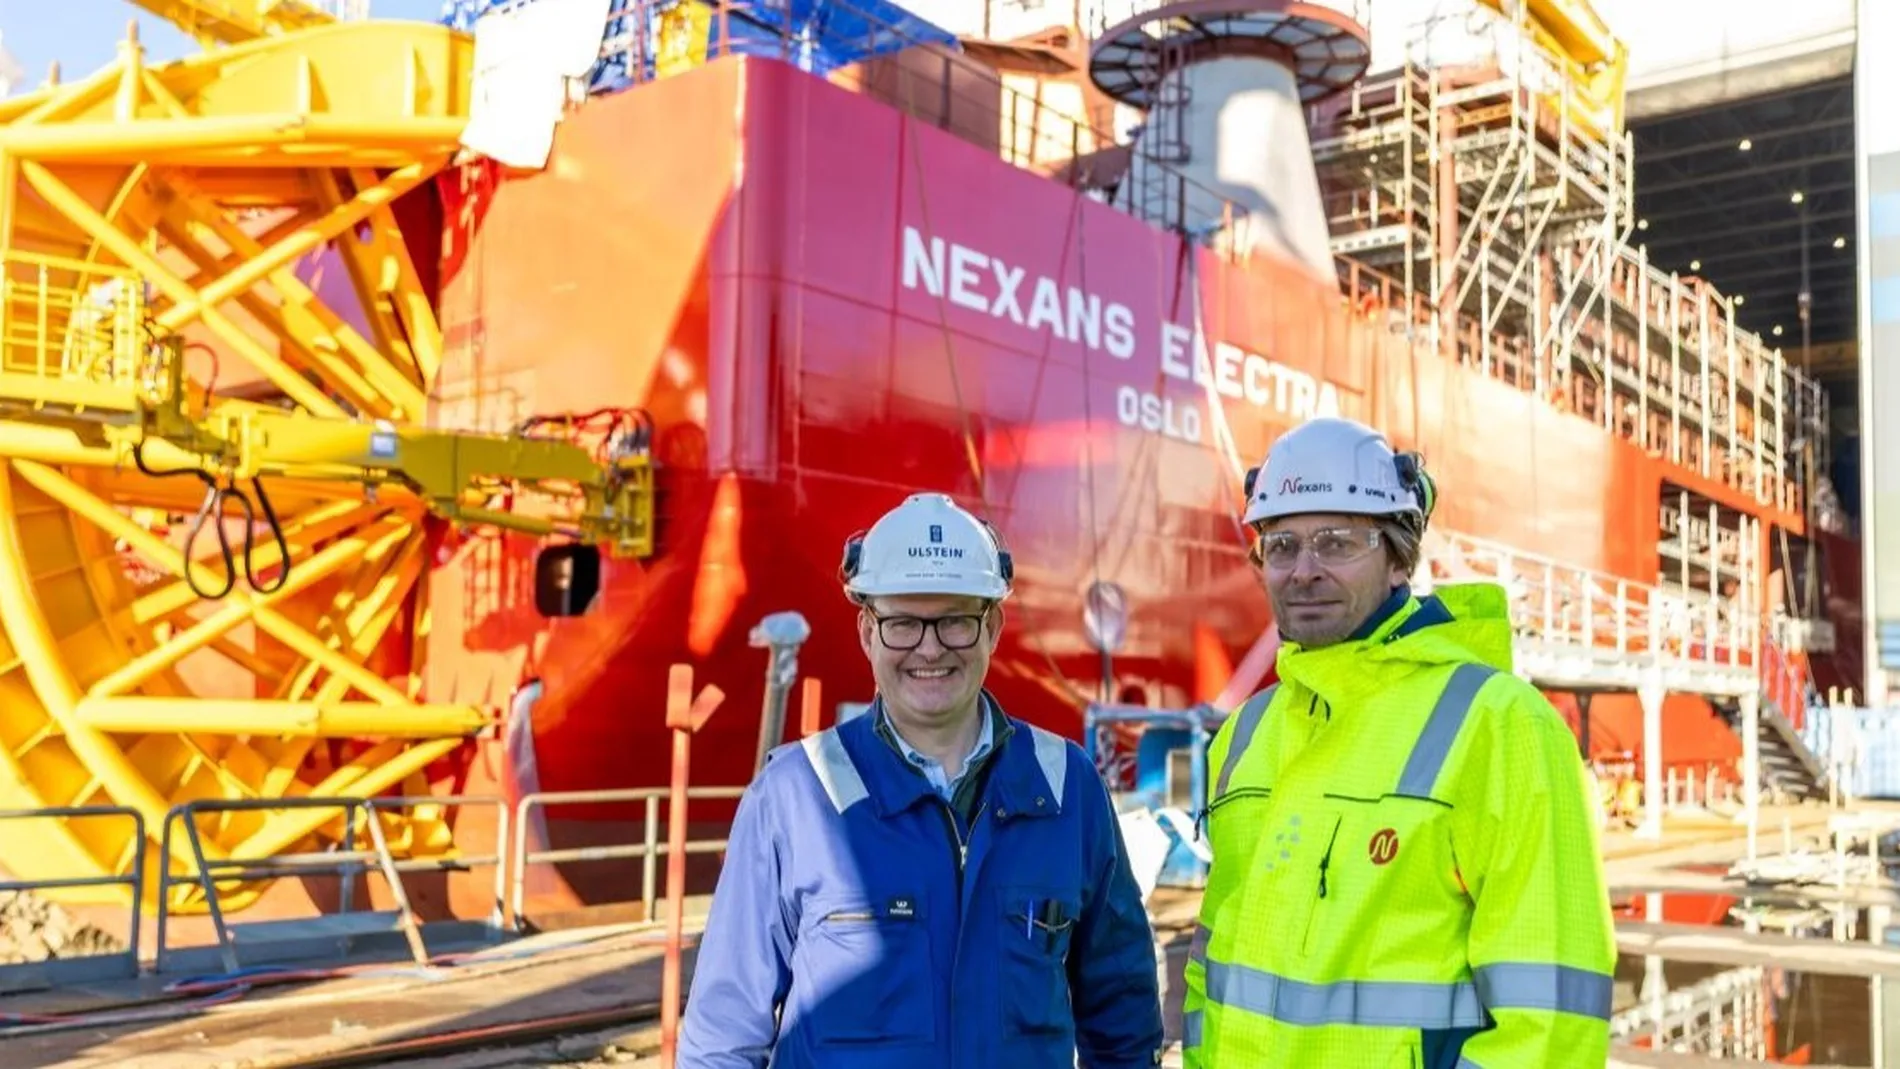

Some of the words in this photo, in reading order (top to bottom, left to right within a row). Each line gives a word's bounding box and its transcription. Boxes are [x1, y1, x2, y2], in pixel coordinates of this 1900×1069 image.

[902, 226, 1135, 360] NEXANS
[1160, 321, 1340, 420] ELECTRA
[1117, 386, 1200, 442] OSLO
[1278, 476, 1333, 496] Nexans
[907, 546, 963, 559] ULSTEIN
